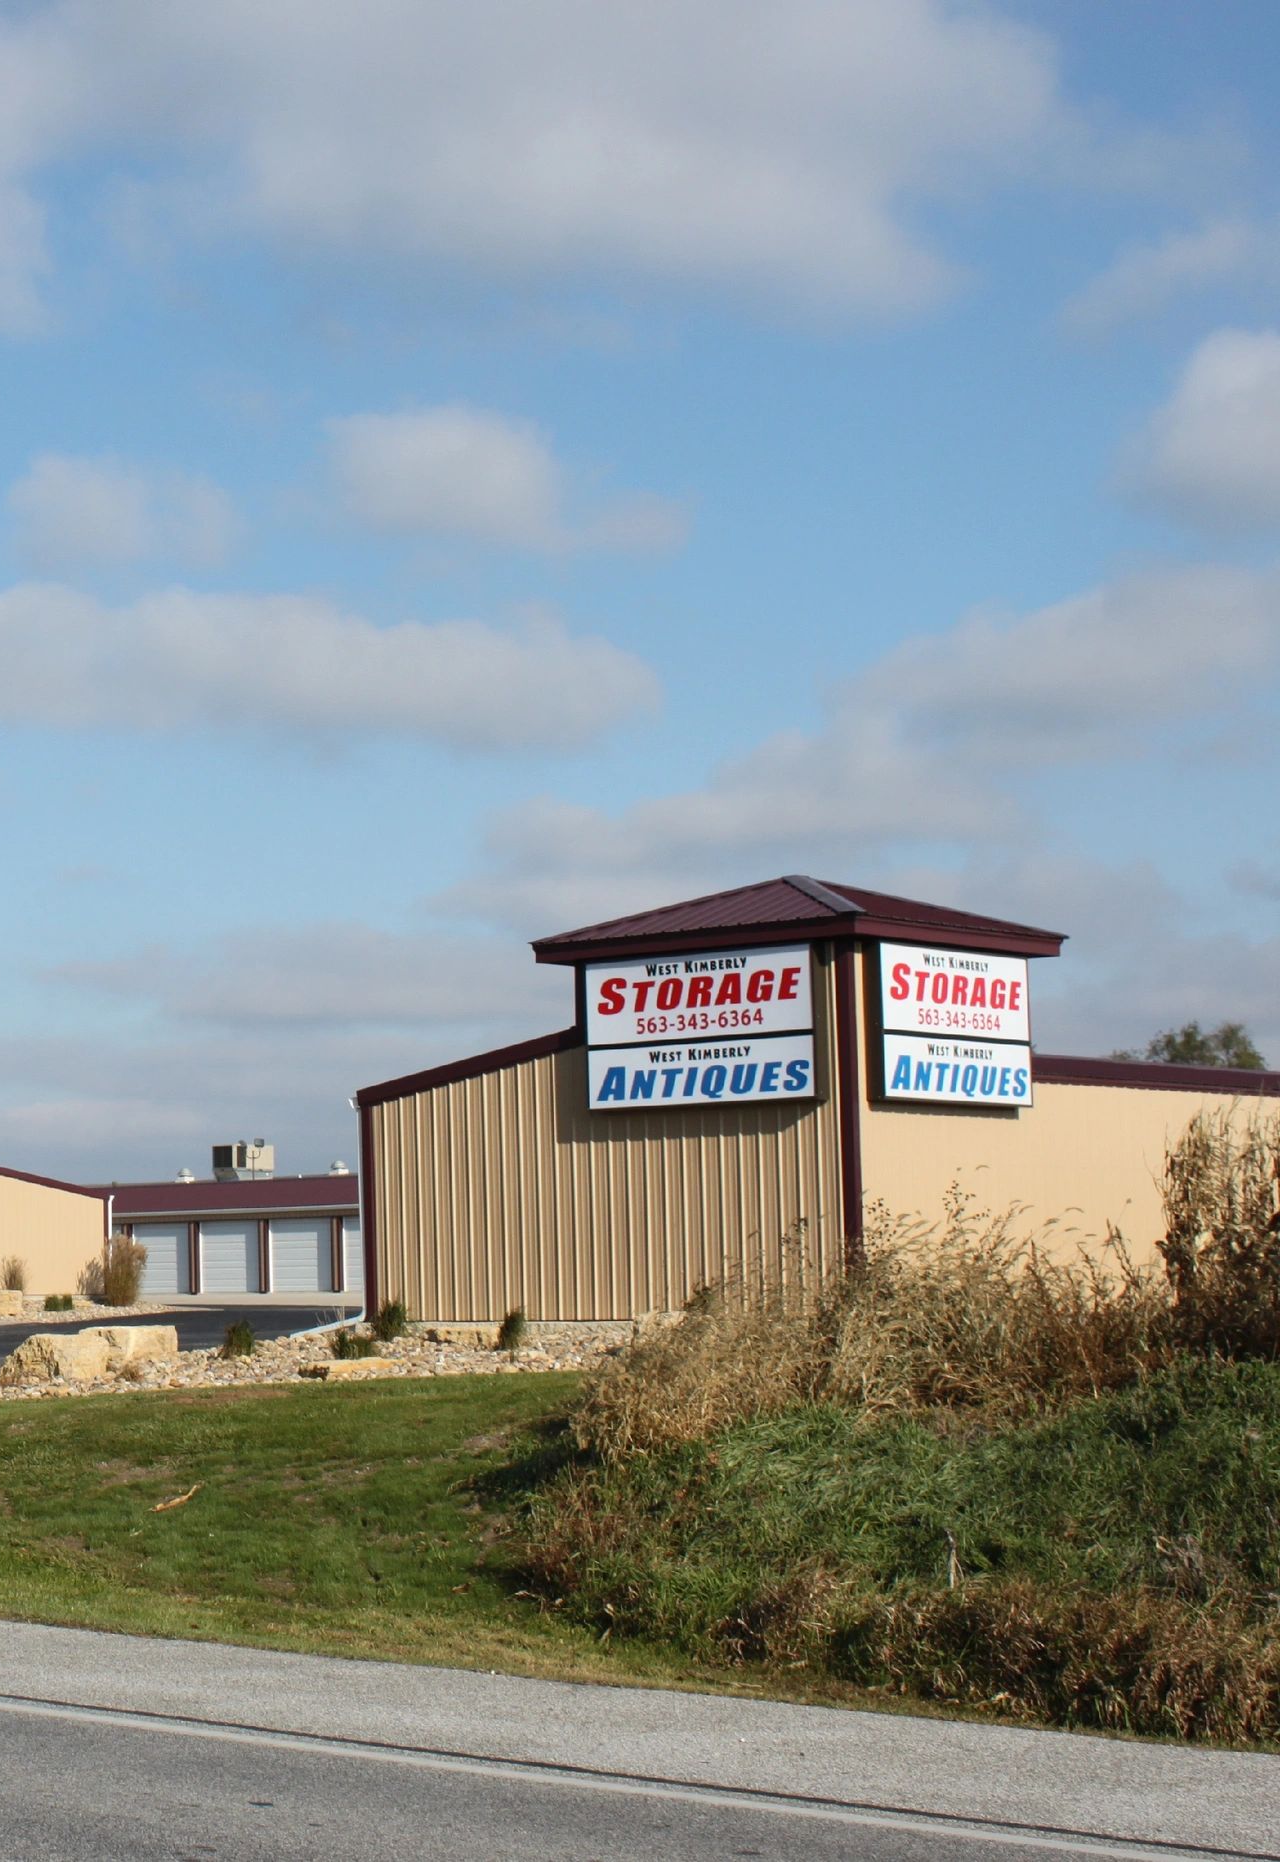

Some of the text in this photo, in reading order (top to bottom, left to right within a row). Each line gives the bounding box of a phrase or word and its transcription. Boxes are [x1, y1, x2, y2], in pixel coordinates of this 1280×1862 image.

[645, 957, 747, 977] WEST KIMBERLY
[923, 954, 988, 973] WEST KIMBERLY
[597, 967, 801, 1016] STORAGE
[890, 963, 1021, 1011] STORAGE
[636, 1008, 763, 1035] 563-343-6364
[918, 1008, 1000, 1031] 563-343-6364
[649, 1046, 751, 1063] WEST KIMBERLY
[927, 1044, 993, 1060] WEST KIMBERLY
[597, 1059, 810, 1102] ANTIQUES
[891, 1055, 1028, 1097] ANTIQUES
